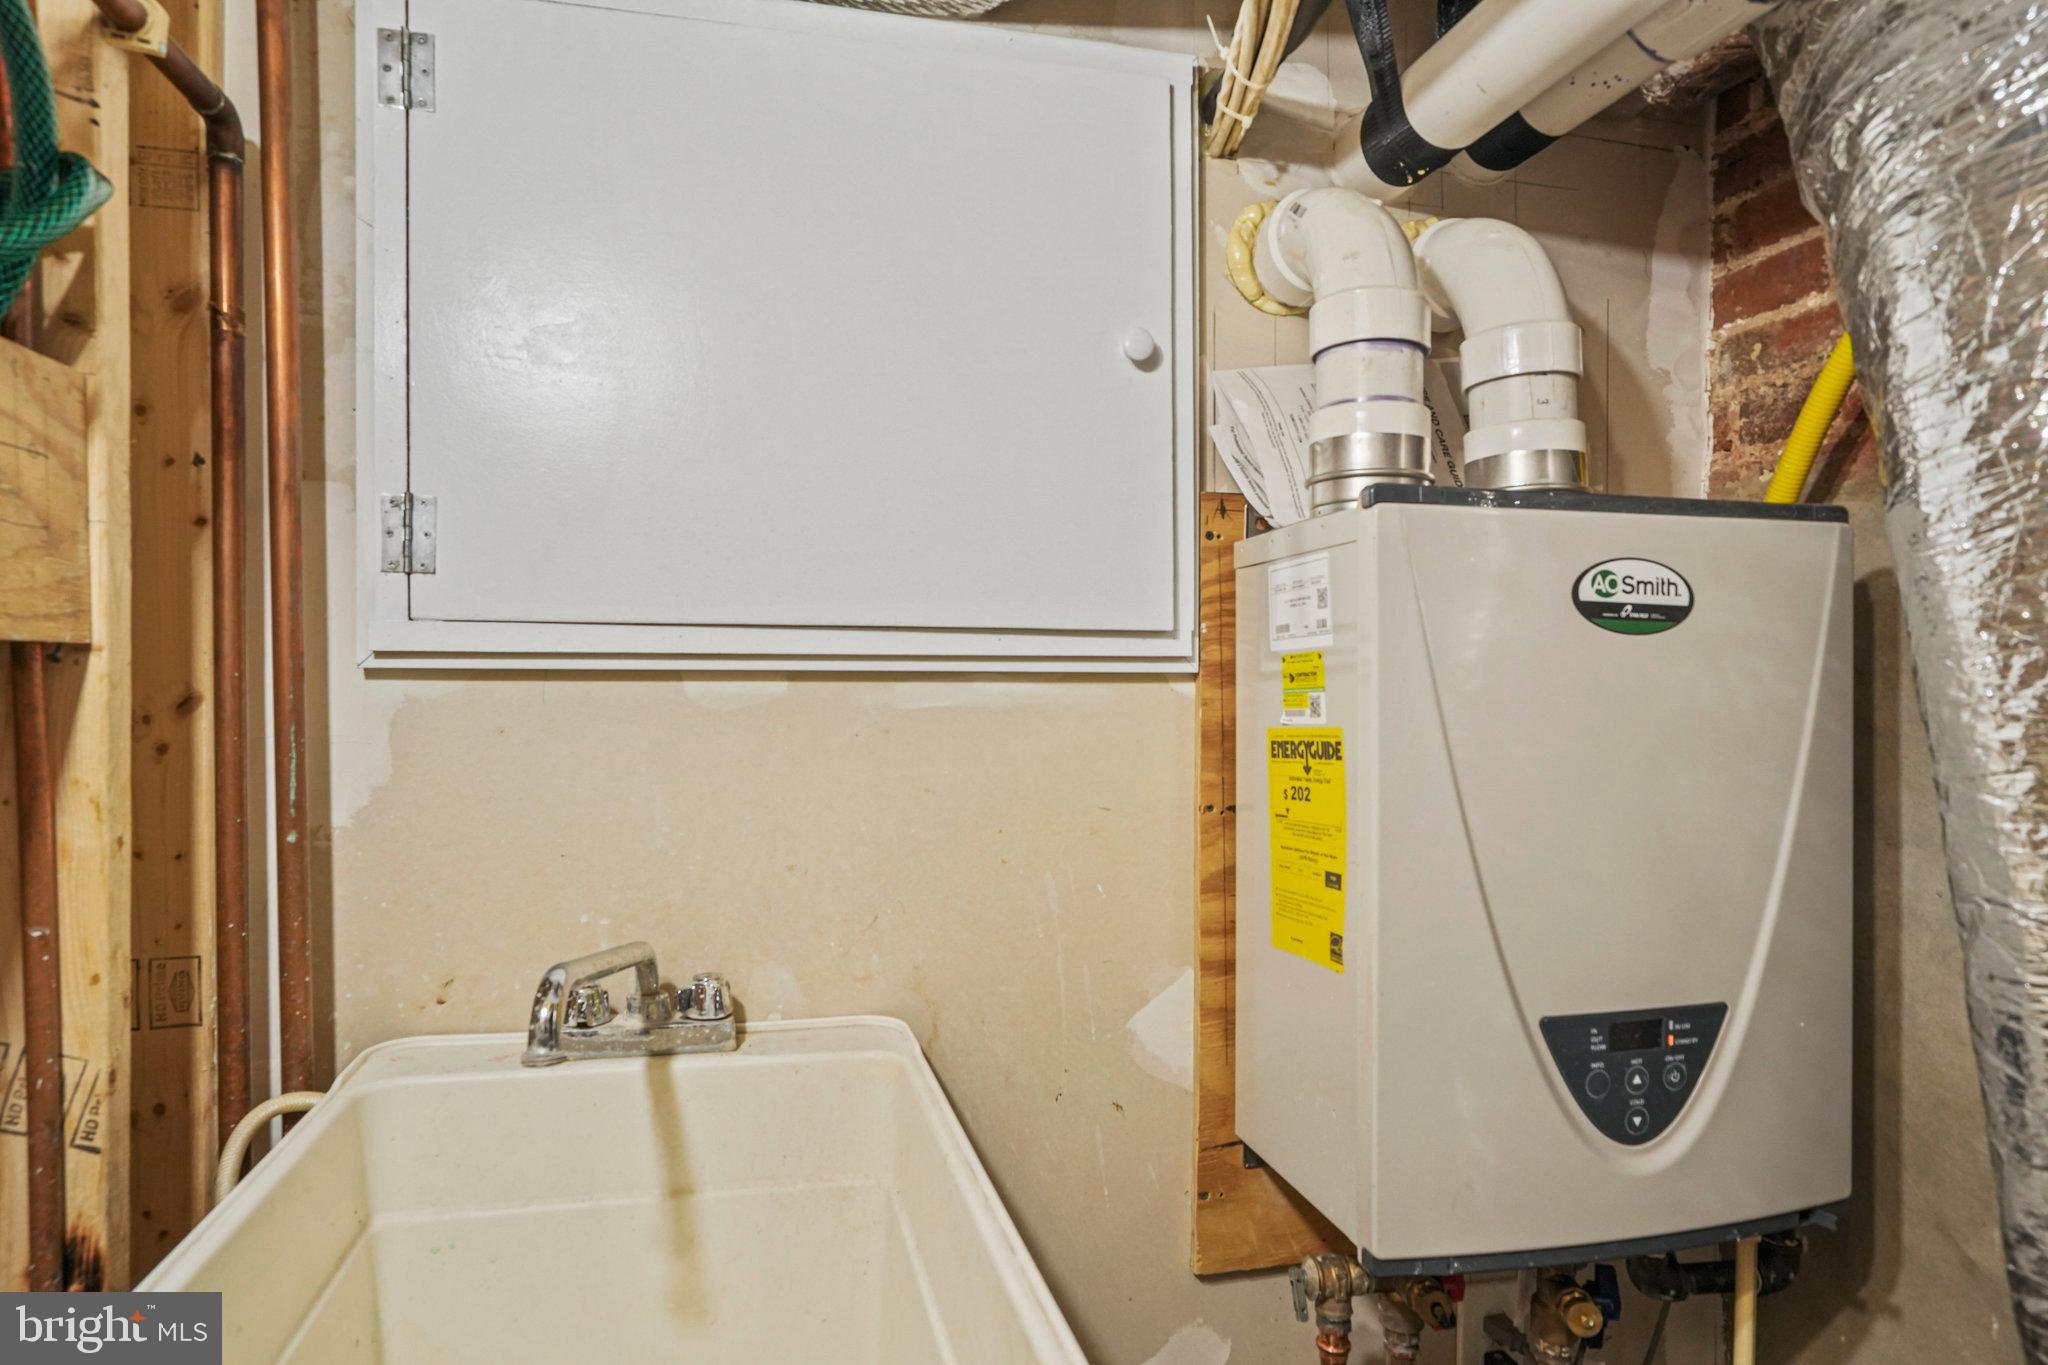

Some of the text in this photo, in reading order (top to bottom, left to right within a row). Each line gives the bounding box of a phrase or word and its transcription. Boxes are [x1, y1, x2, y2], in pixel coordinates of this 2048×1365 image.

[1435, 428, 1453, 460] CARE
[1447, 460, 1463, 488] GUID
[1622, 575, 1679, 597] Smith
[1271, 740, 1342, 761] ENERGYGUIDE
[1290, 785, 1311, 802] 202
[5, 1102, 23, 1126] HD
[80, 1119, 98, 1142] HD
